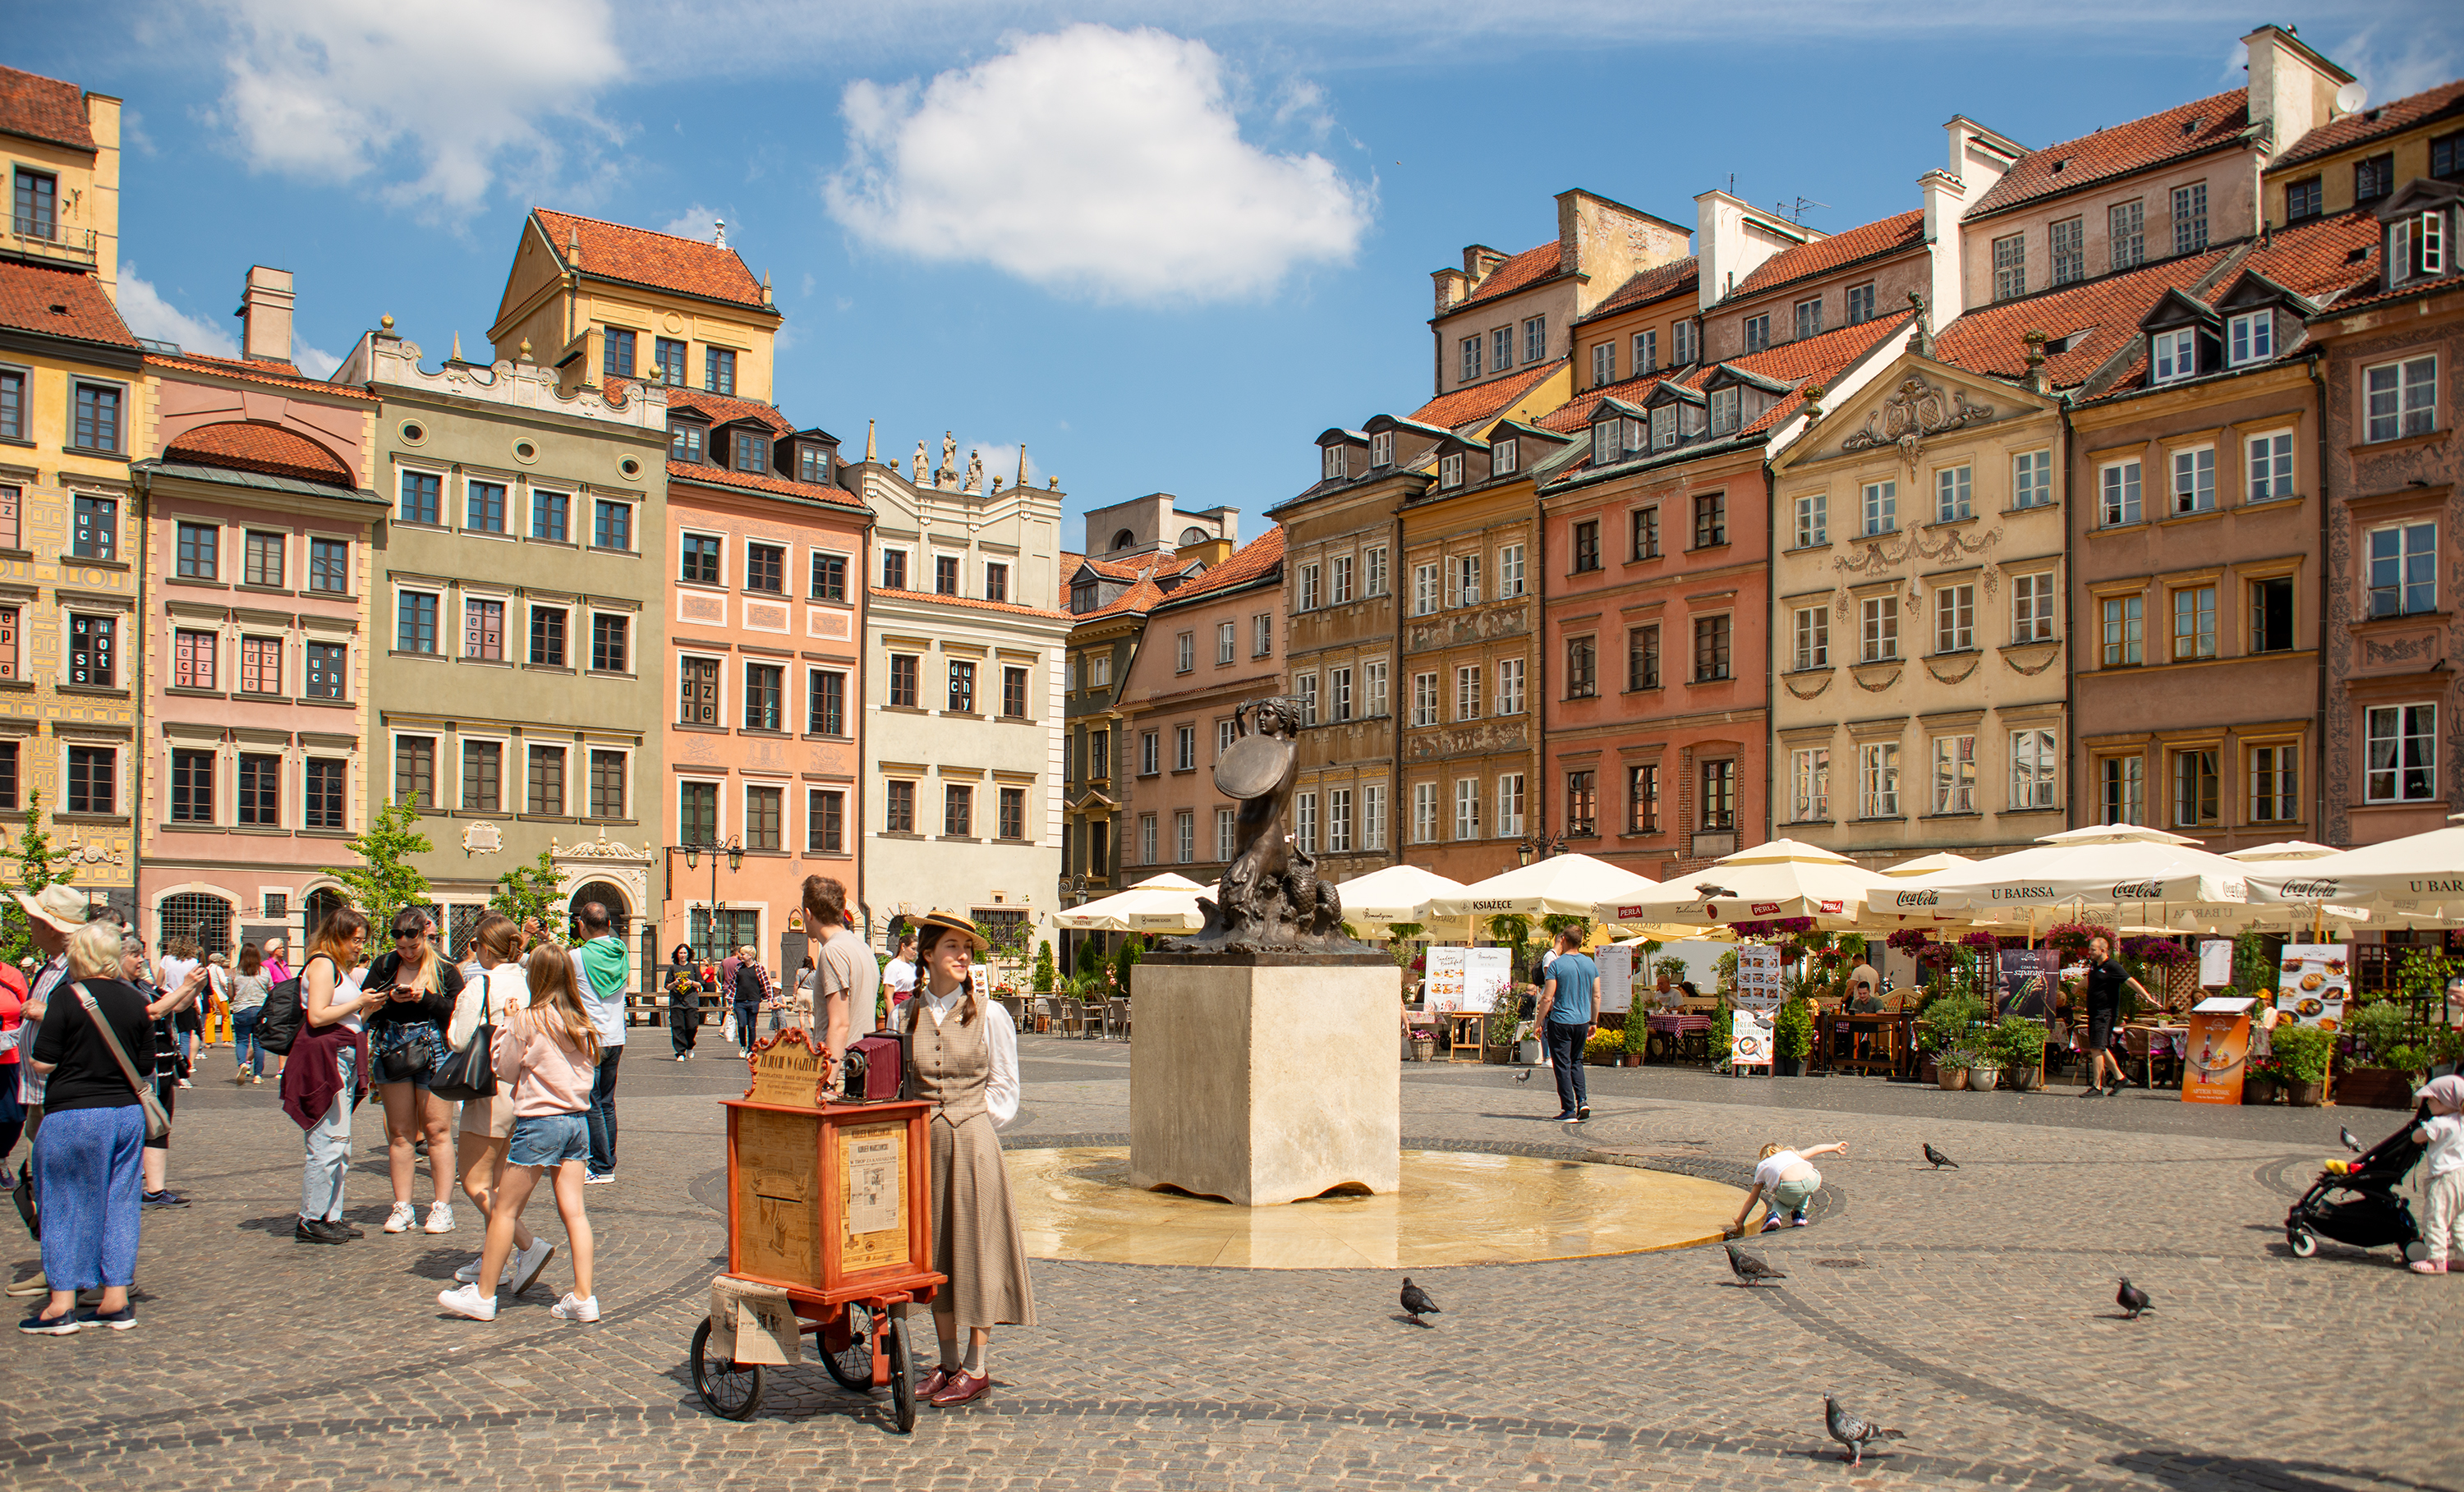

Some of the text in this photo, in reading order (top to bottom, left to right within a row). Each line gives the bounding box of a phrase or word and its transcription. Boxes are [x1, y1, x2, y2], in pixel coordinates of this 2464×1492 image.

[2410, 880, 2422, 893] U
[1991, 887, 2055, 900] U BARSSA
[1473, 898, 1513, 911] KSIĄŻĘCE
[1754, 905, 1778, 914] PERŁA
[1823, 902, 1841, 911] PERŁA
[1620, 908, 1641, 917] PERŁA
[2013, 968, 2045, 979] szparagi
[760, 1054, 820, 1072] ZDJĘCIE W GAZECIE
